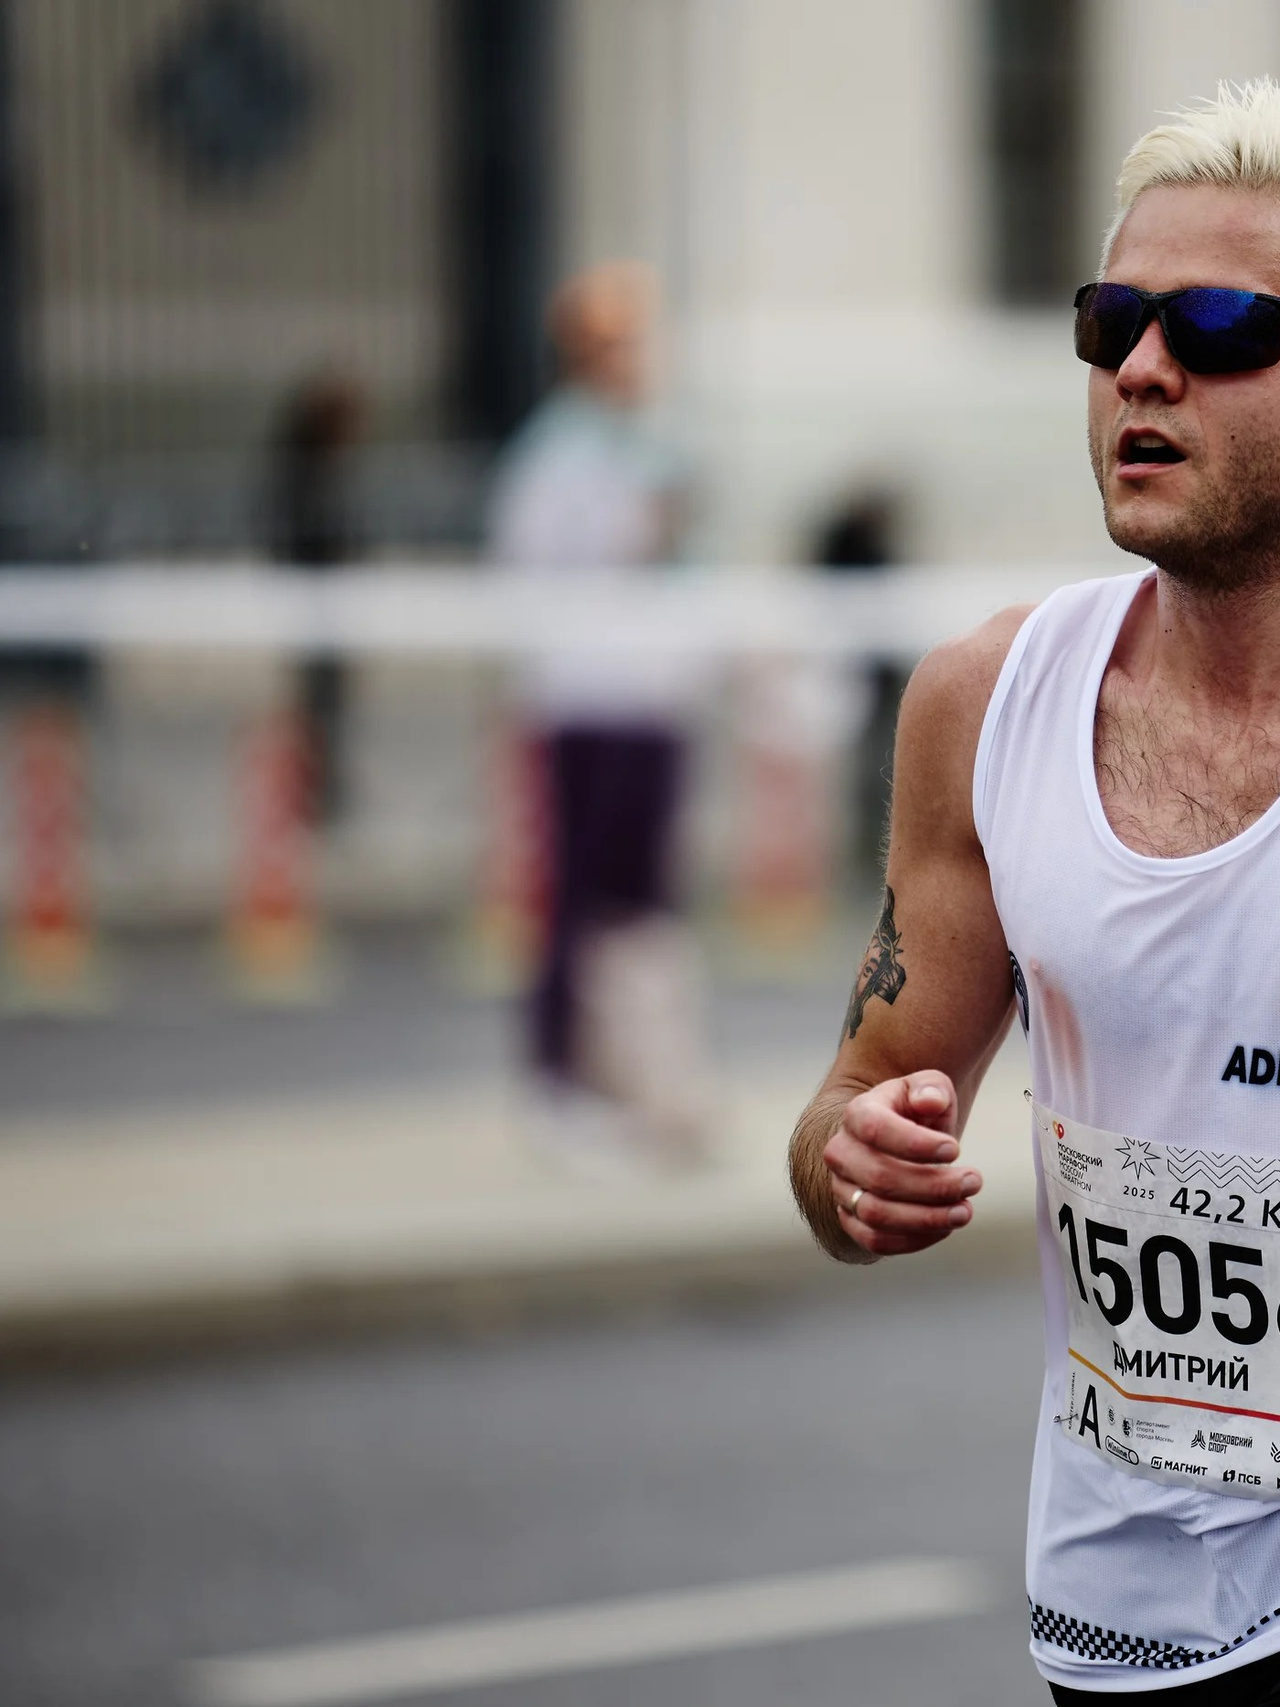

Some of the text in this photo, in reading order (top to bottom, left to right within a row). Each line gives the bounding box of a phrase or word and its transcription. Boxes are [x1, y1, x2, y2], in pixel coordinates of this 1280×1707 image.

[1057, 1142, 1103, 1168] МОСКОВСКИЙ
[1058, 1151, 1088, 1173] МАРАФОН
[1059, 1160, 1084, 1180] MOSCOW
[1060, 1170, 1092, 1192] MARATHON
[1123, 1185, 1155, 1200] 2025
[1169, 1187, 1246, 1224] 42,2
[1113, 1340, 1249, 1391] ДМИТРИЙ
[1208, 1441, 1228, 1454] СПОРТ
[1209, 1431, 1253, 1449] МОСКОВСКИЙ
[1164, 1460, 1208, 1476] МАГНИТ
[1238, 1473, 1261, 1485] ПСБ
